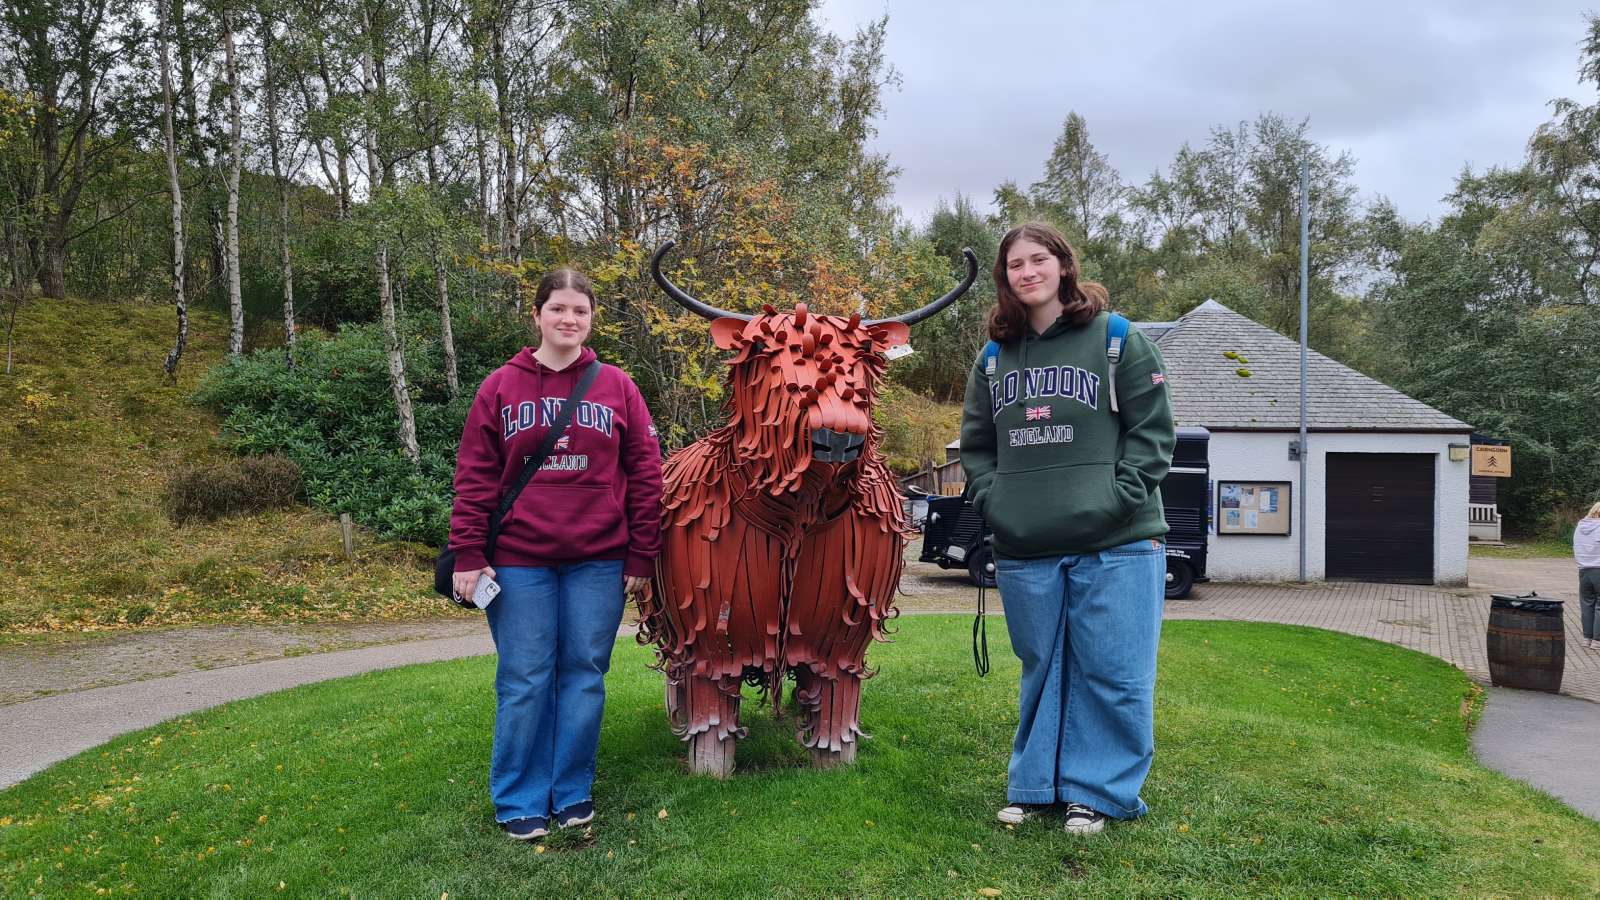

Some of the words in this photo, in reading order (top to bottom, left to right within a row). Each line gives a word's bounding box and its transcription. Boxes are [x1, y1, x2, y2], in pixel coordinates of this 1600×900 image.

[990, 365, 1100, 418] LONDON
[1009, 425, 1074, 447] ENGLAND
[523, 455, 588, 471] GLAND
